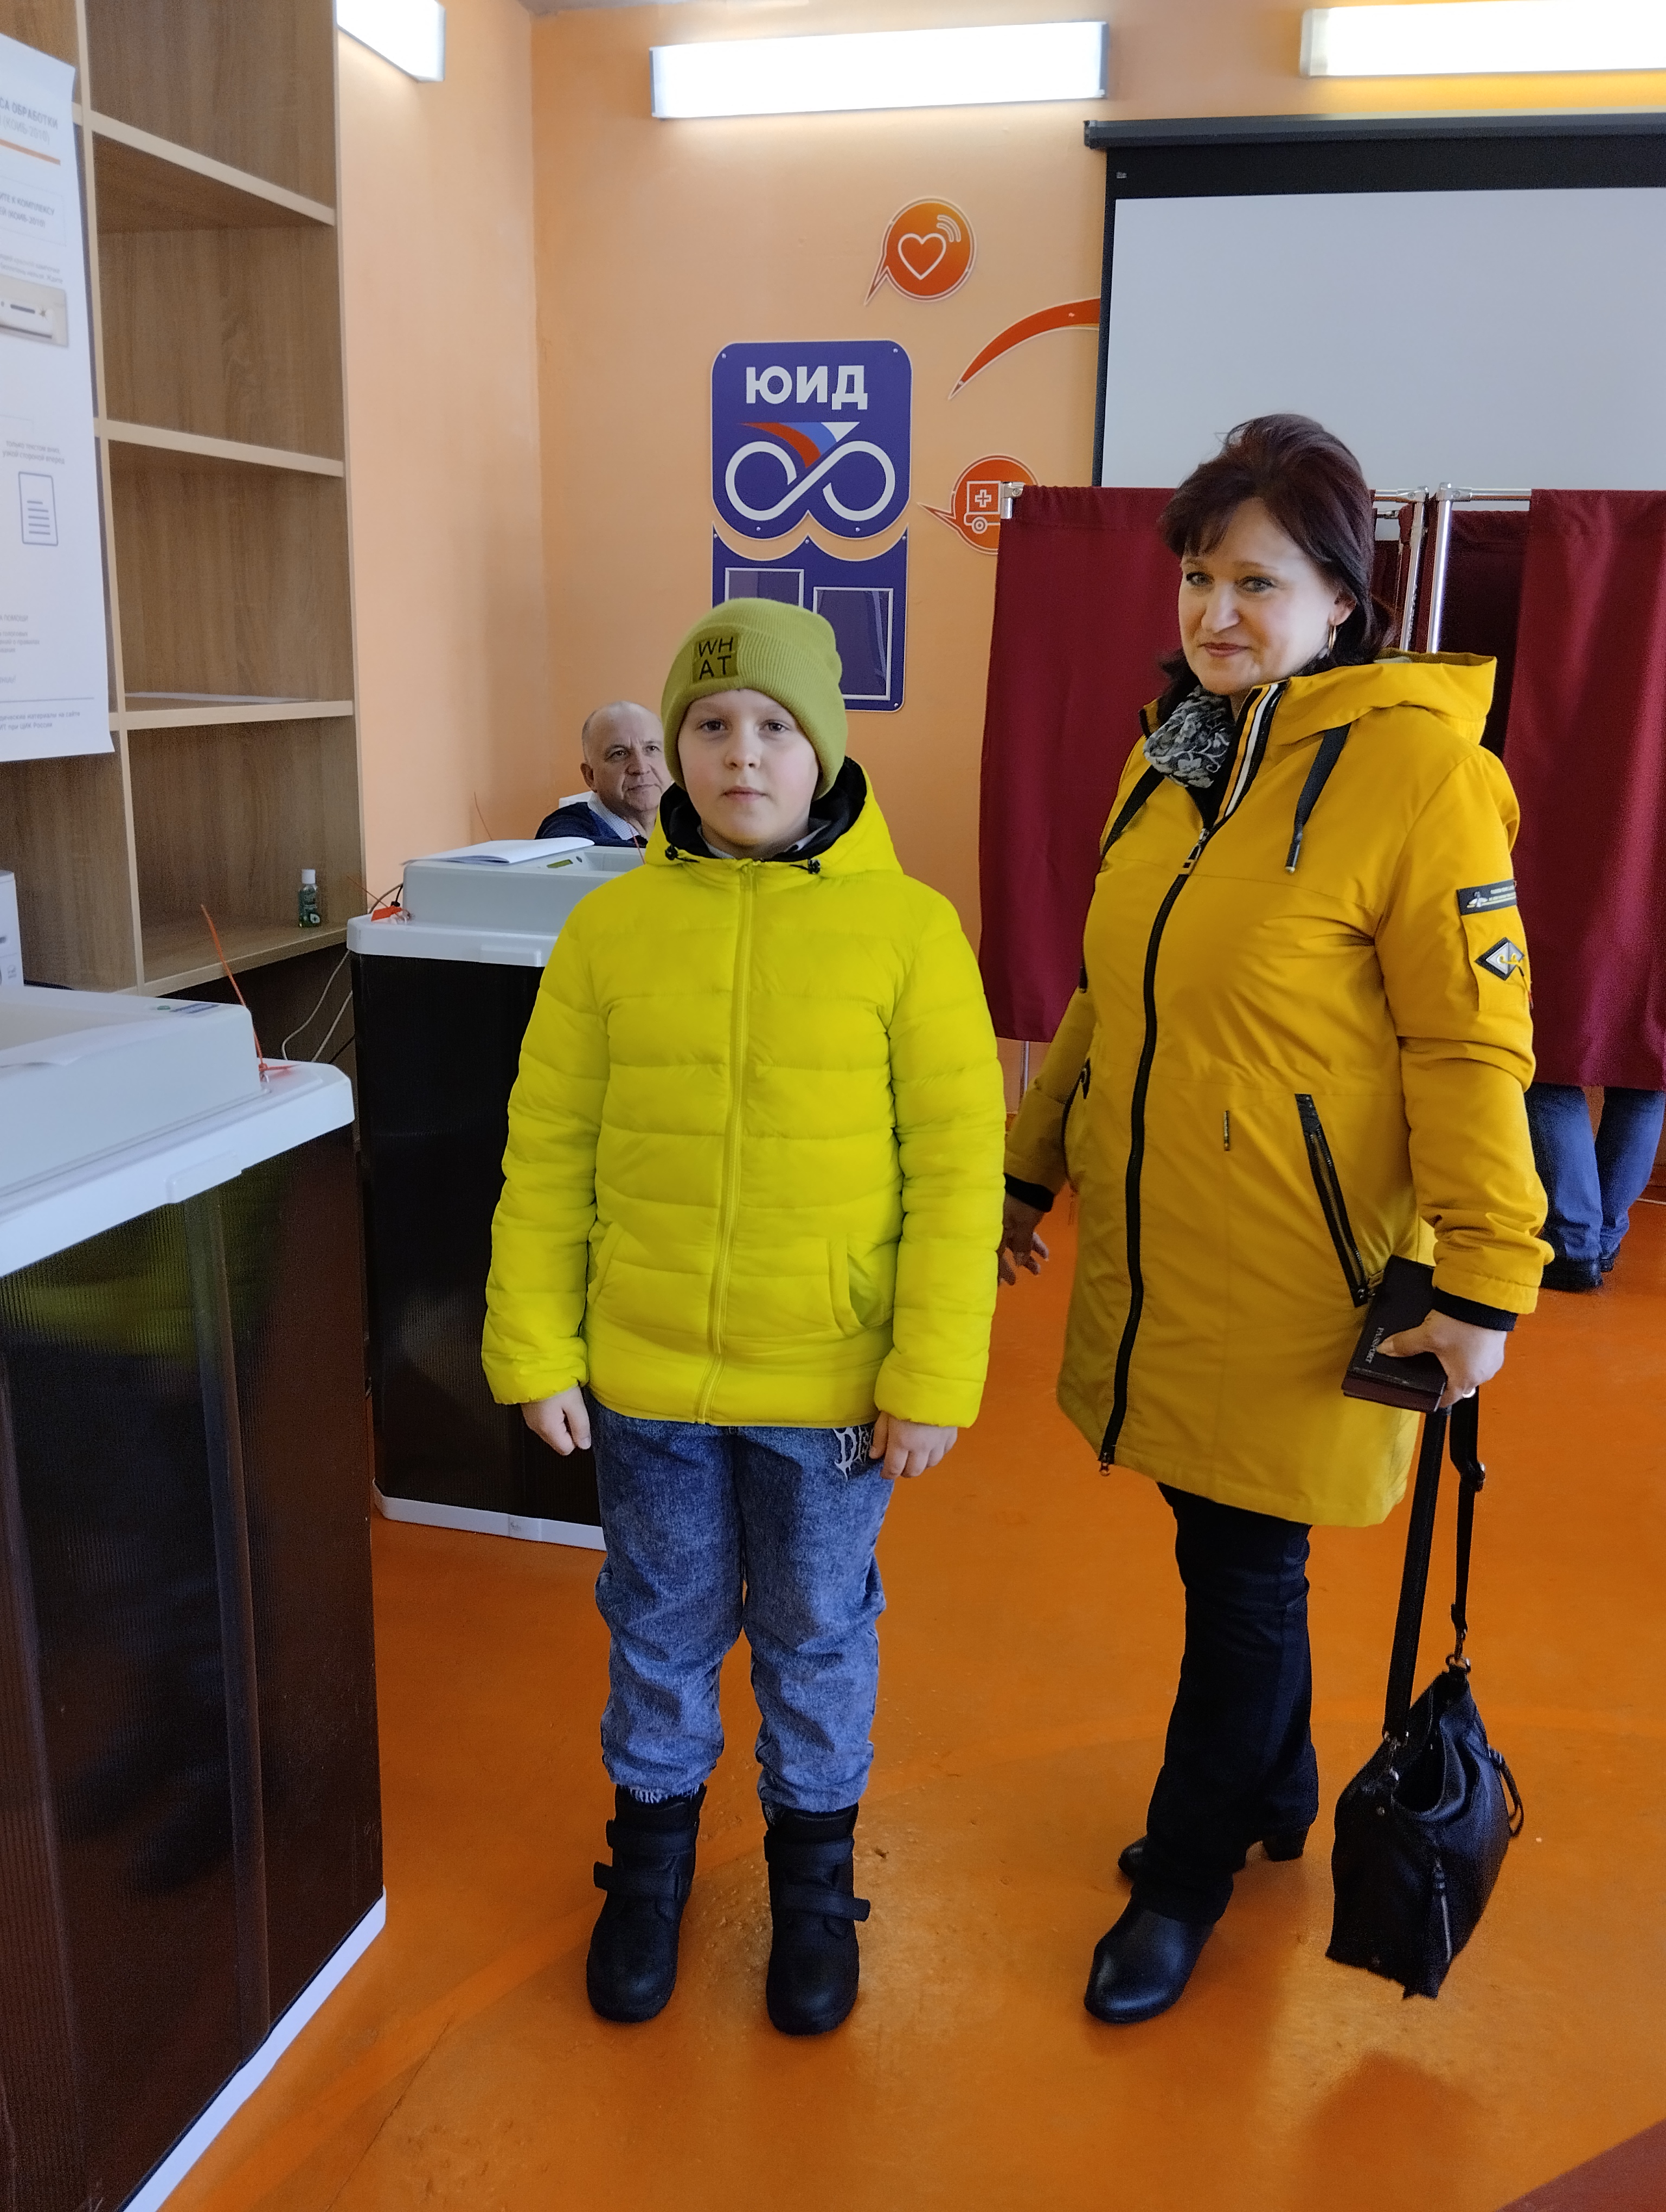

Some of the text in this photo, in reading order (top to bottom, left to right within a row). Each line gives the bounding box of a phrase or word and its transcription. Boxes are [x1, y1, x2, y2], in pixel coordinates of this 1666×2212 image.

[12, 102, 58, 130] ОБРАБОТКИ
[3, 115, 50, 145] (КОИБ-2010)
[17, 197, 55, 216] КОМПЛЕКСУ
[8, 210, 46, 229] (КОИБ-2010)
[746, 365, 868, 410] ЮИД
[6, 440, 24, 449] только
[25, 443, 46, 452] текстом
[20, 452, 44, 461] стороной
[699, 636, 733, 658] WH
[699, 655, 732, 680] AT
[1366, 1327, 1385, 1364] PASSPORT
